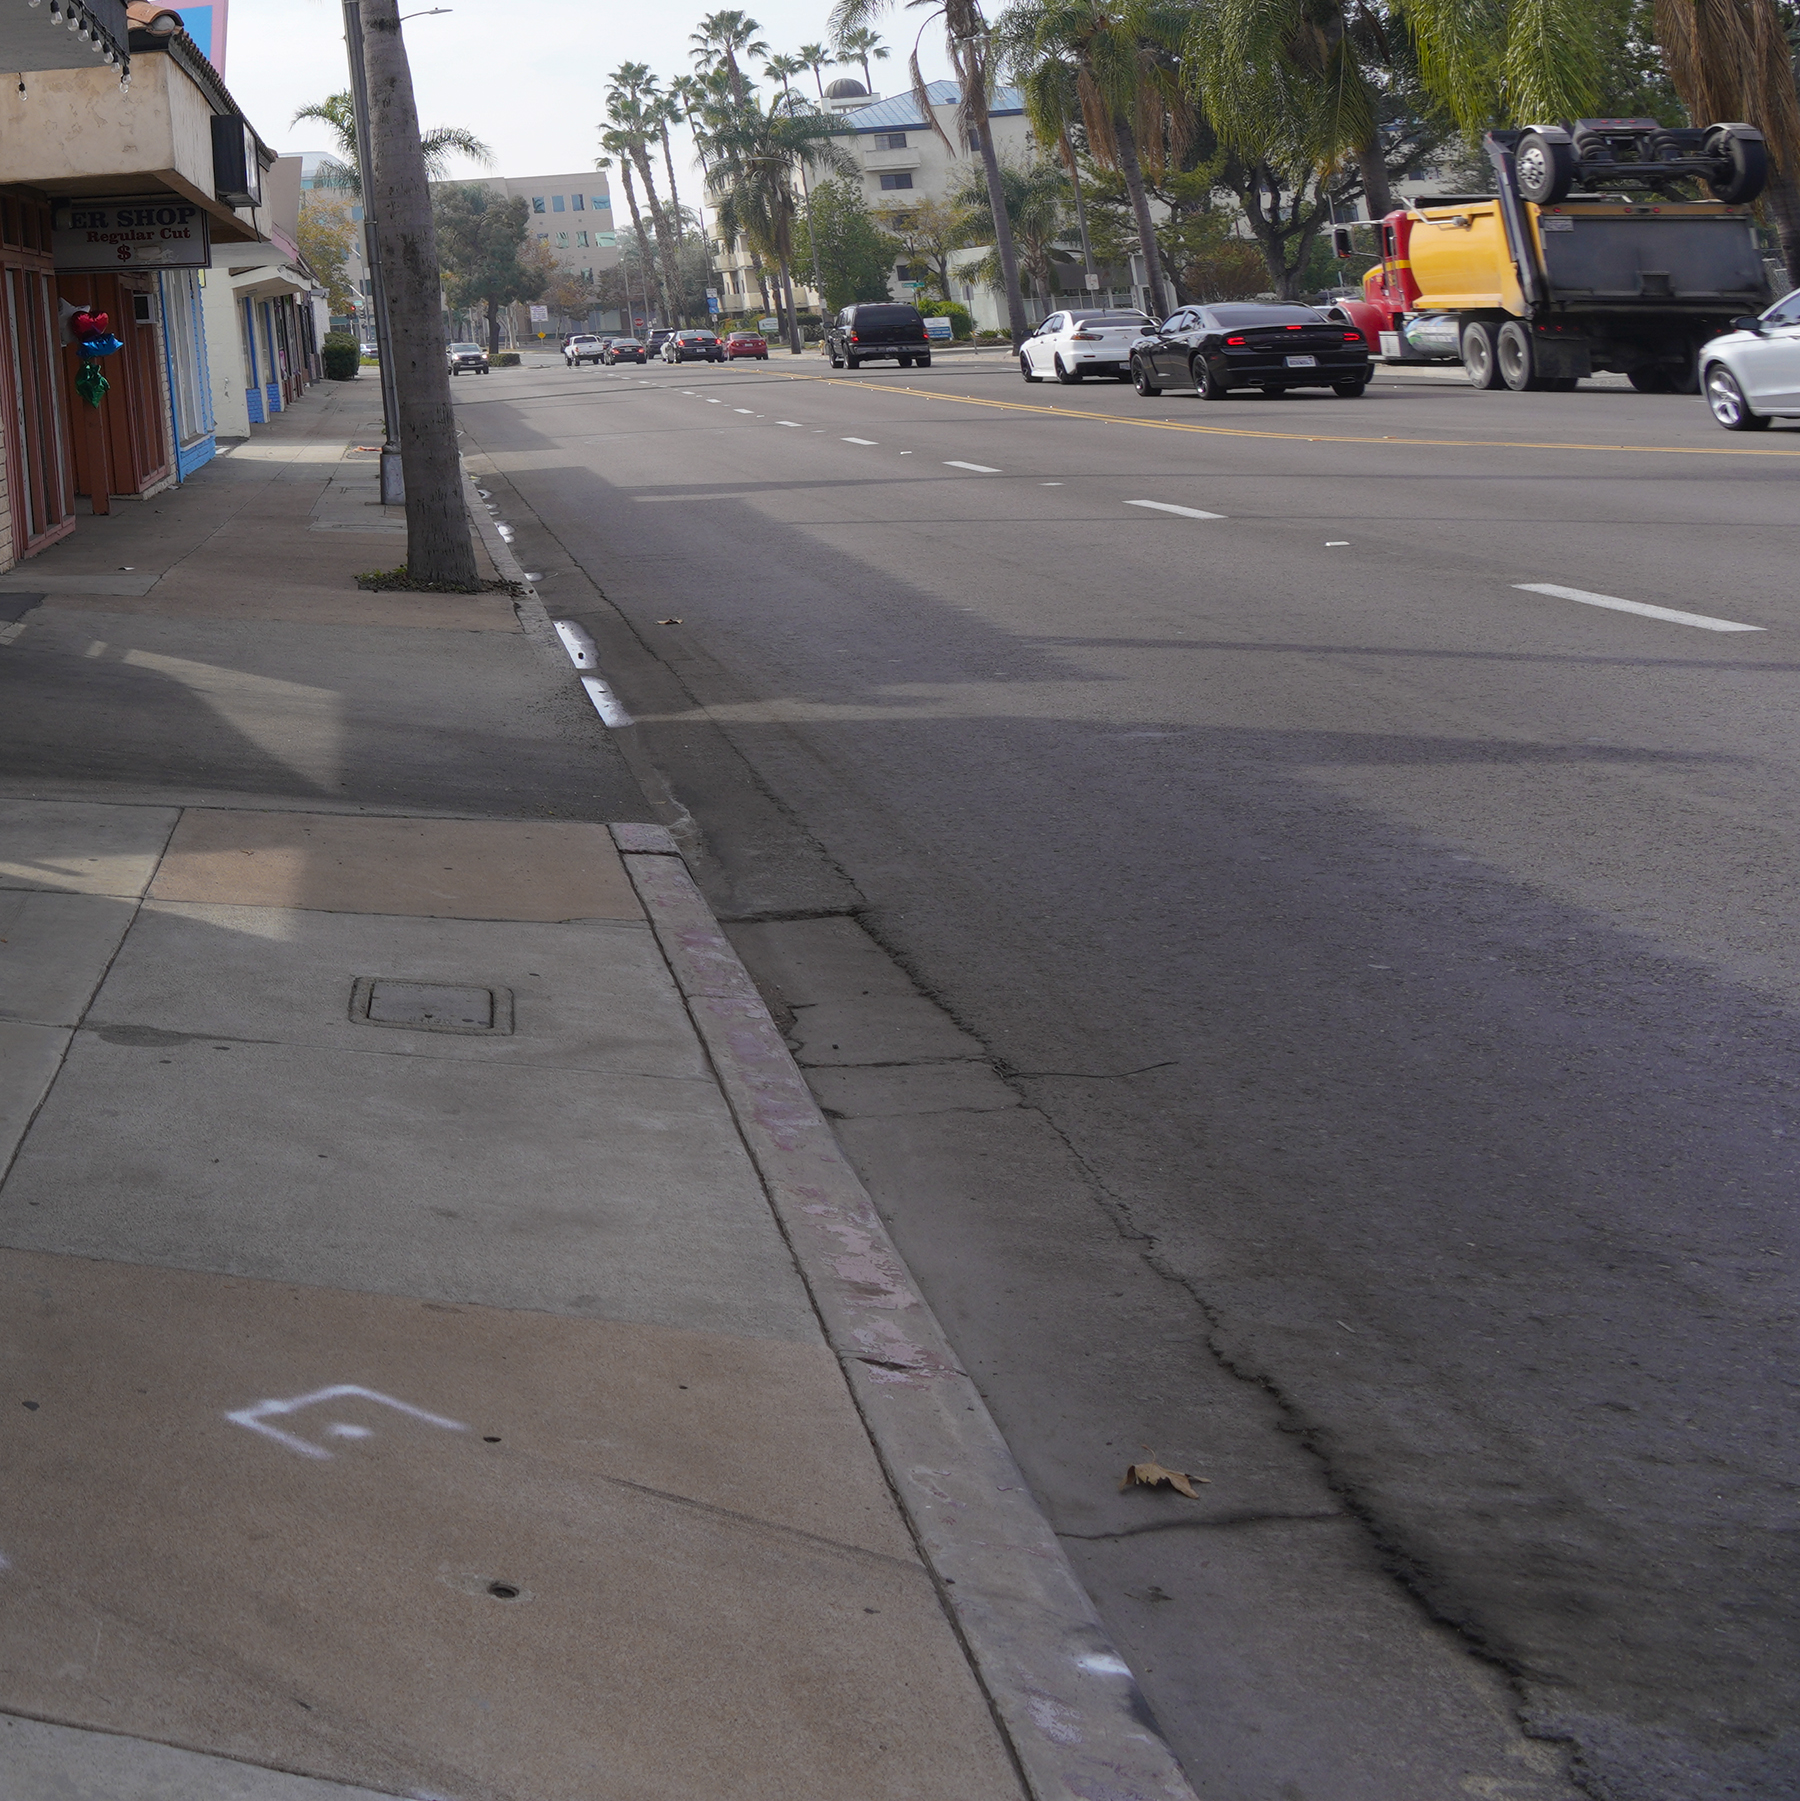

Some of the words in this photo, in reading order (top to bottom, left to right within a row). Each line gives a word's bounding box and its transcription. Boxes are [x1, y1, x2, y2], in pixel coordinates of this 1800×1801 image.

[116, 207, 197, 228] SHOP
[86, 229, 155, 245] Regular
[159, 227, 191, 240] Cut
